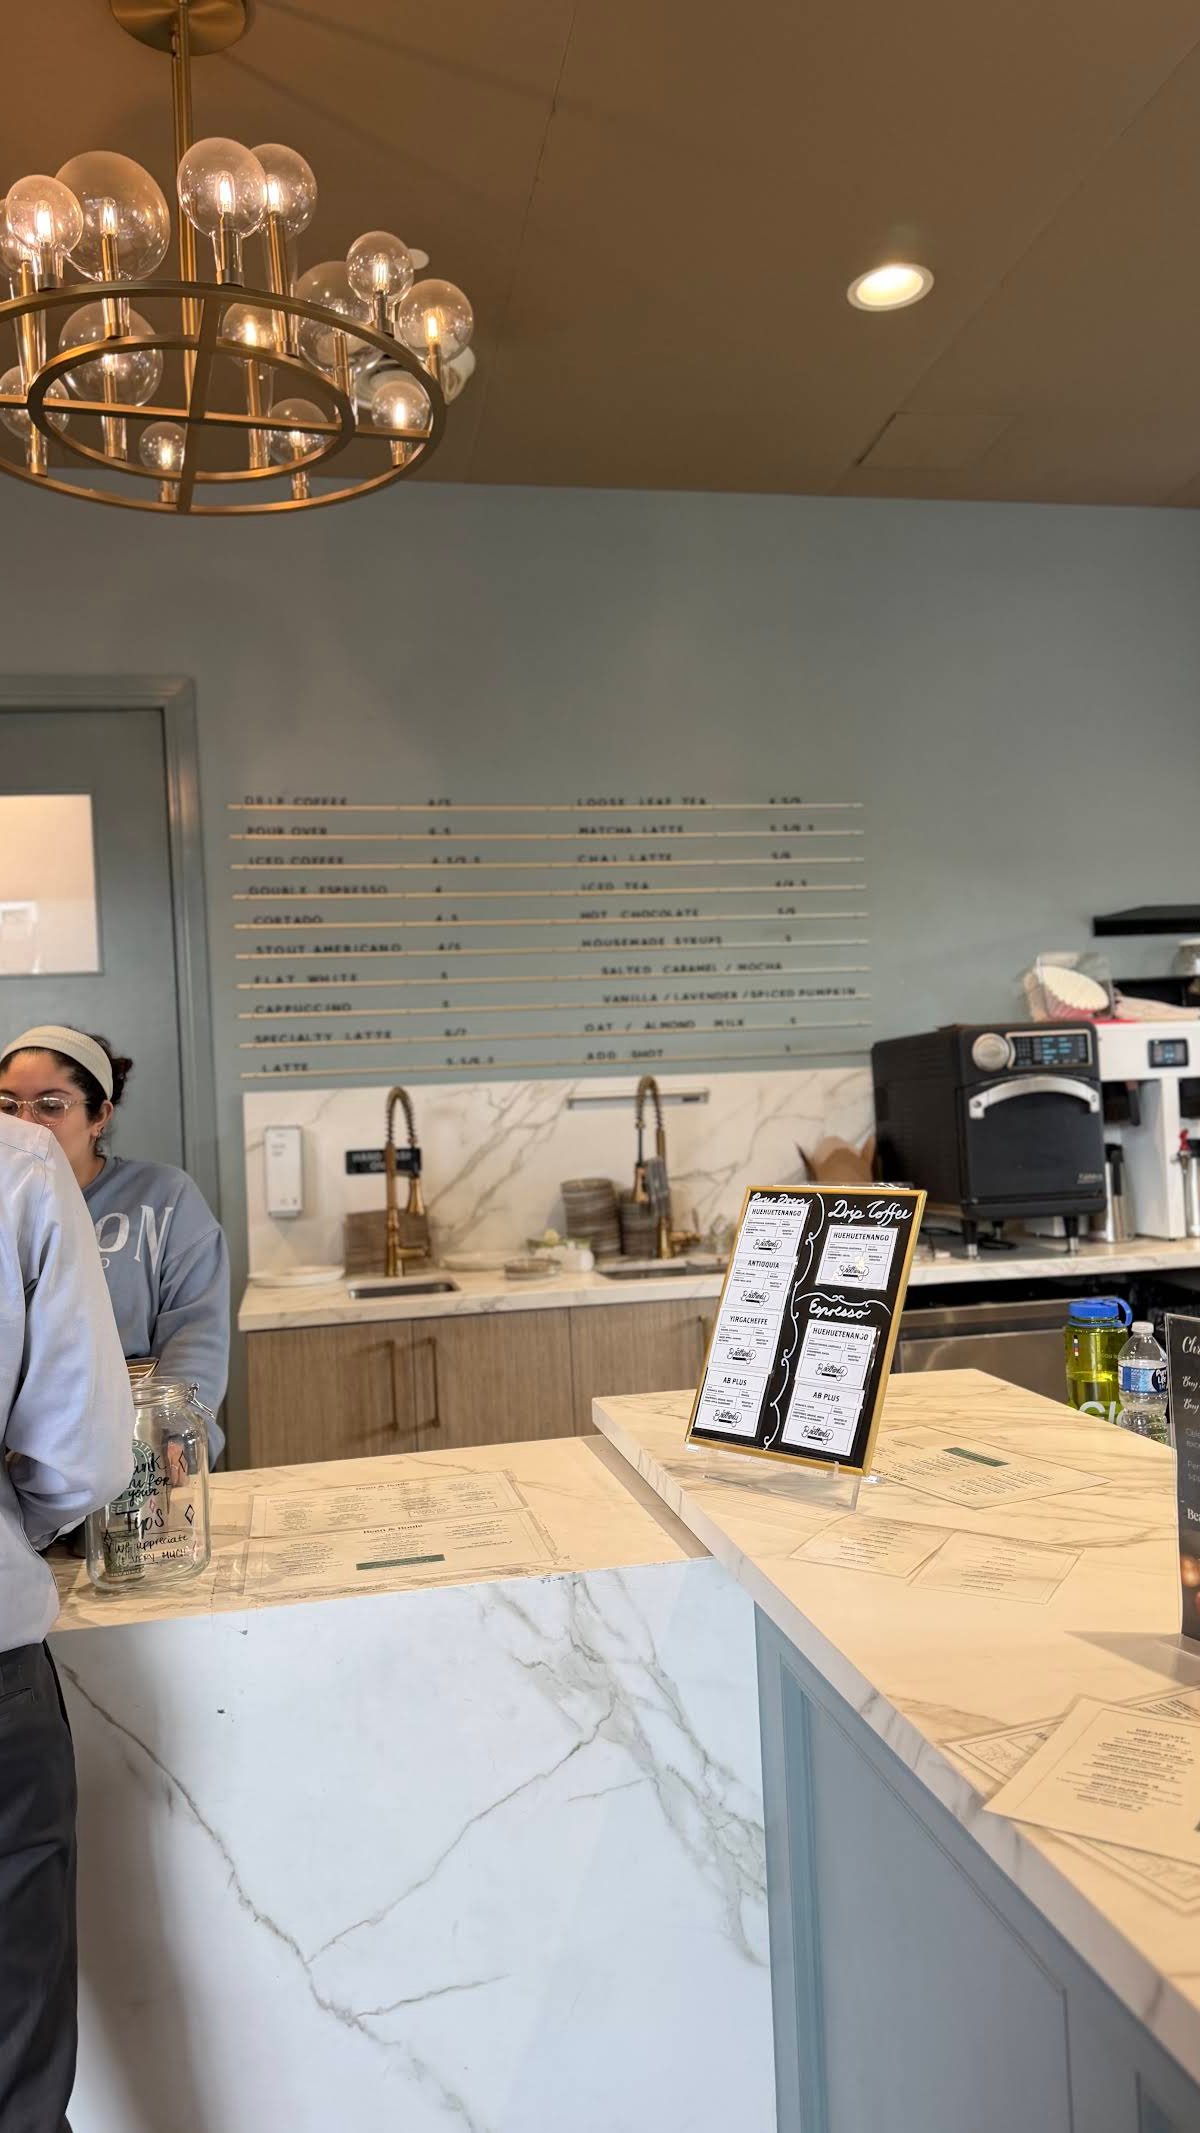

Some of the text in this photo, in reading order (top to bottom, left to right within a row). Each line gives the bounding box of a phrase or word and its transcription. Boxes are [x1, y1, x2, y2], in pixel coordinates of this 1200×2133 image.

[293, 797, 347, 806] COFFEE
[577, 798, 625, 806] LOOSE
[682, 797, 707, 806] TEA
[247, 826, 284, 836] POUR
[291, 826, 328, 836] OVER
[578, 825, 633, 835] MATCHA
[642, 825, 684, 834] LATTE
[249, 856, 284, 866] ICED
[290, 856, 344, 865] COFFEE
[577, 854, 618, 864] CHAI
[628, 853, 672, 862] LATTE
[248, 886, 307, 896] DOUBLE
[318, 885, 388, 894] ESPRESSO
[581, 882, 615, 892] ICED
[624, 882, 649, 890] TEA
[580, 910, 608, 920] HOT
[620, 908, 700, 918] CHOCOLATE
[254, 915, 324, 924] CORTADO
[582, 936, 666, 948] HOUSEMADE
[674, 936, 722, 946] SYRUPS
[256, 945, 305, 954] STOUT
[313, 944, 402, 954] AMERICANO
[601, 965, 652, 976] SALTED
[662, 964, 717, 973] CARAMEL
[738, 962, 783, 972] MOCHA
[254, 974, 294, 984] FLAT
[307, 974, 358, 983] WHITE
[604, 993, 658, 1004] VANILLA
[674, 990, 738, 1001] LAVENDER
[798, 987, 856, 998] PUMPKIN
[254, 1002, 352, 1014] CAPPUCCINO
[584, 1022, 613, 1032] OAT
[644, 1019, 696, 1030] ALMOND
[714, 1018, 744, 1028] MILK
[254, 1032, 333, 1044] SPECIALTY
[345, 1030, 392, 1040] LATTE
[586, 1051, 617, 1060] ADD
[631, 1049, 664, 1059] SHOT
[262, 1062, 309, 1073] LATTE
[751, 1208, 802, 1217] HUEHUETENANGO
[828, 1199, 913, 1226] Drip Coffee
[833, 1232, 890, 1241] HUEHUETENANGO
[747, 1260, 780, 1269] ANTIOQUIA
[808, 1298, 872, 1319] Espresso
[722, 1376, 748, 1386] AB PLUS
[823, 1393, 840, 1402] PLUS
